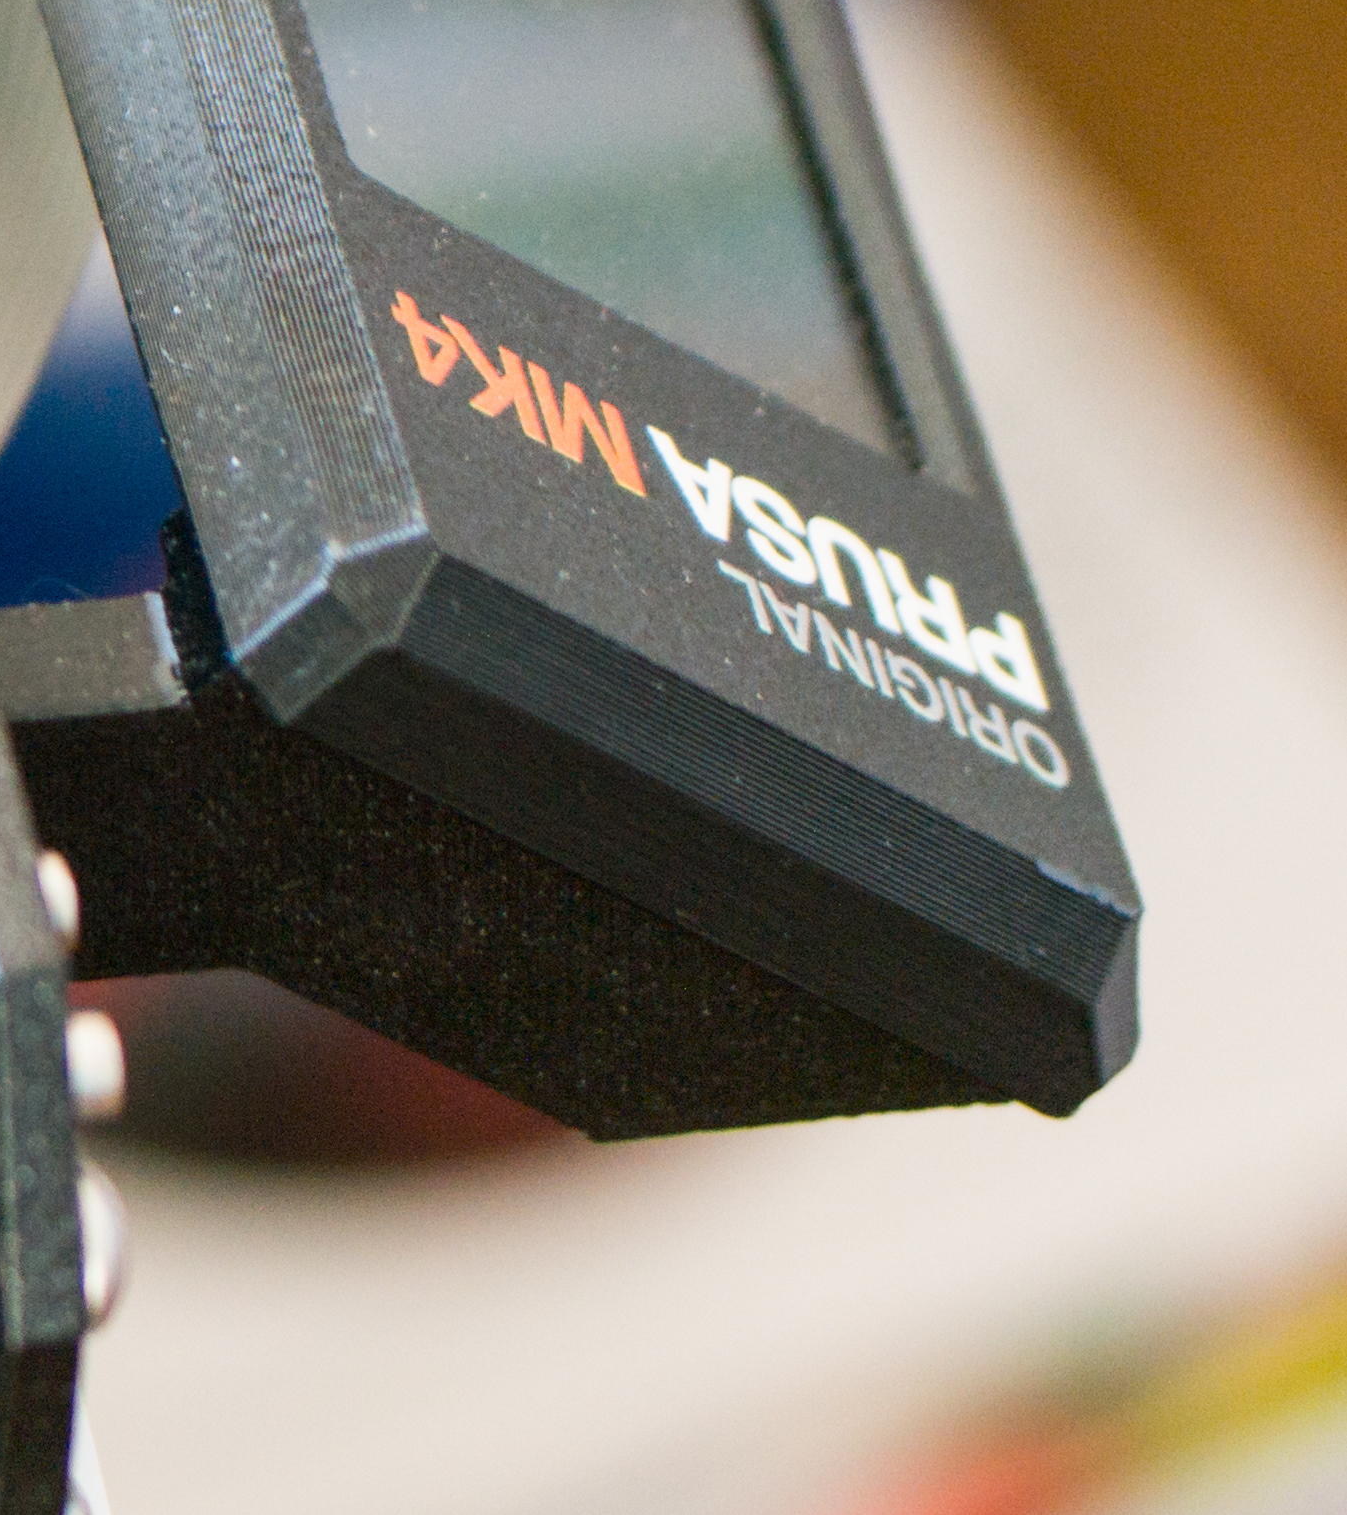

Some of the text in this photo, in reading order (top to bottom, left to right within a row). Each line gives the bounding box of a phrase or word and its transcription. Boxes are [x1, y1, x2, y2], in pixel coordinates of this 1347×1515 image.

[391, 291, 1050, 710] PRUSA MK4
[718, 561, 1070, 788] ORIGINAL
